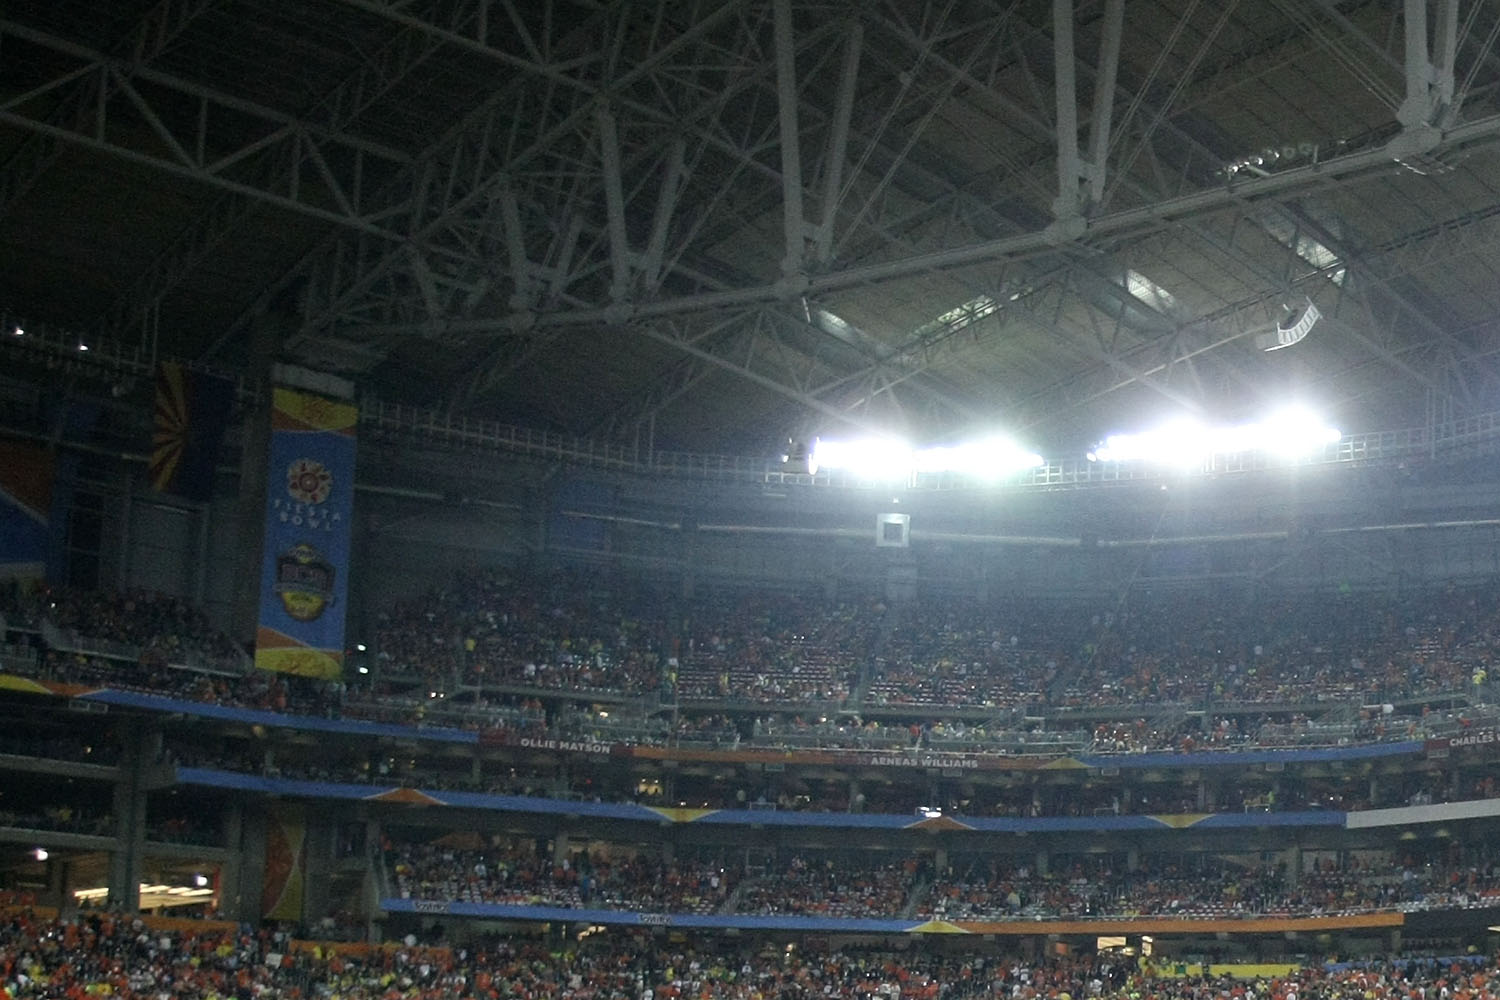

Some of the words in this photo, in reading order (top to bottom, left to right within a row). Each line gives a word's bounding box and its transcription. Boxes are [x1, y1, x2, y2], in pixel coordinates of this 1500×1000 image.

[520, 738, 555, 749] OLLIE
[559, 740, 611, 754] MATSON
[1450, 733, 1494, 747] CHARLES
[871, 757, 918, 767] AENEAS
[921, 757, 978, 769] WILLIAMS
